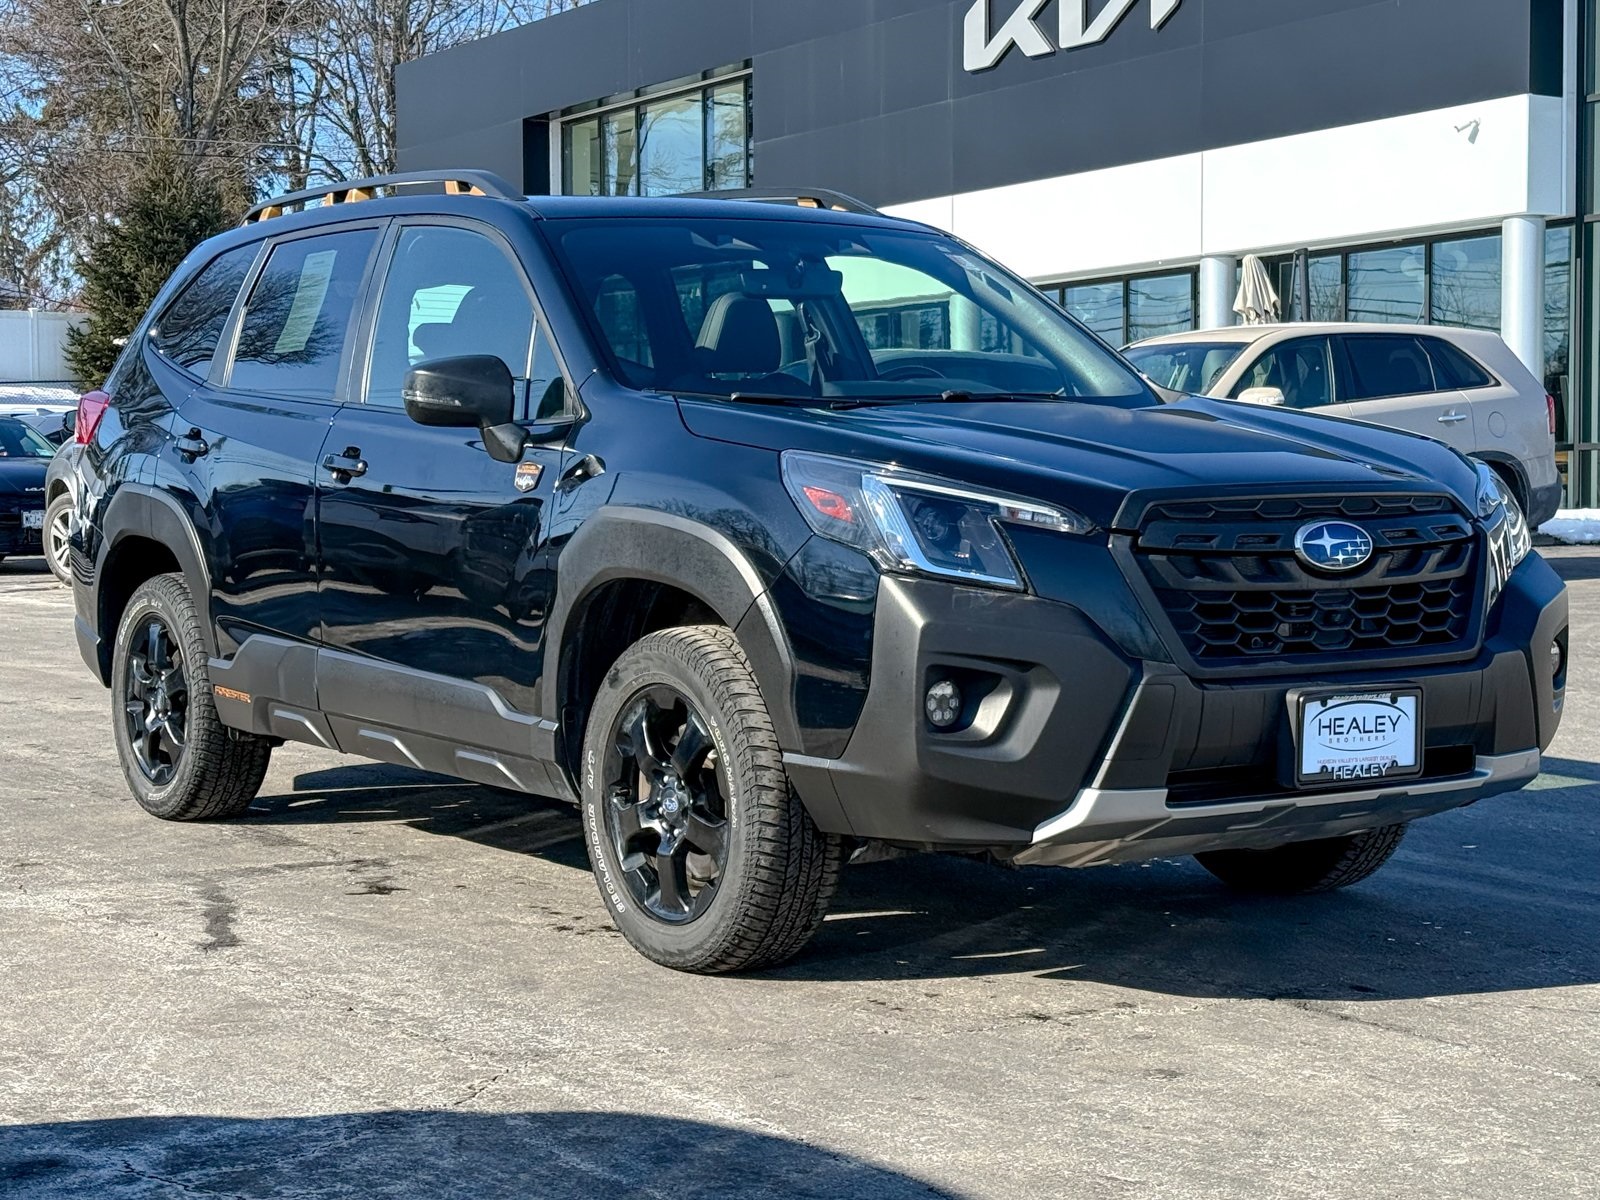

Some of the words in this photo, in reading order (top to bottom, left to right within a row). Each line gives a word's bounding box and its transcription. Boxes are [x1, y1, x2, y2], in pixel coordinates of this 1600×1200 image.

[1318, 714, 1402, 736] HEALEY
[1328, 735, 1386, 744] BROTHERS
[587, 750, 595, 790] A/T
[1333, 763, 1389, 780] HEALEY
[588, 803, 626, 913] GEOLANDAR
